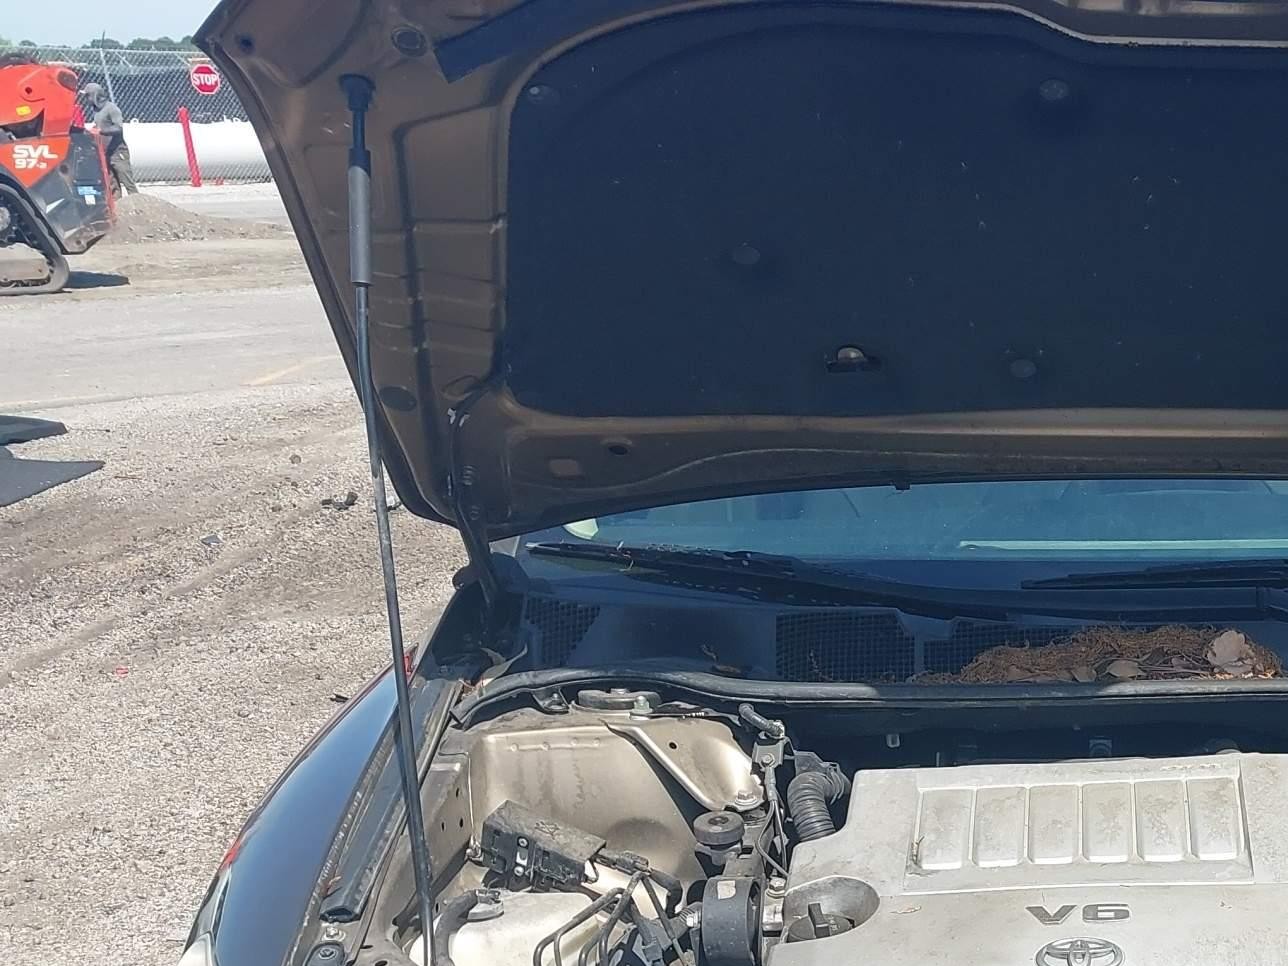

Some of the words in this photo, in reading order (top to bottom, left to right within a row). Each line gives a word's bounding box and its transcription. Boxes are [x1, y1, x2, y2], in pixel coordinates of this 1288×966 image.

[192, 73, 218, 86] STOP
[12, 144, 59, 159] SVL
[1025, 903, 1131, 925] V6
